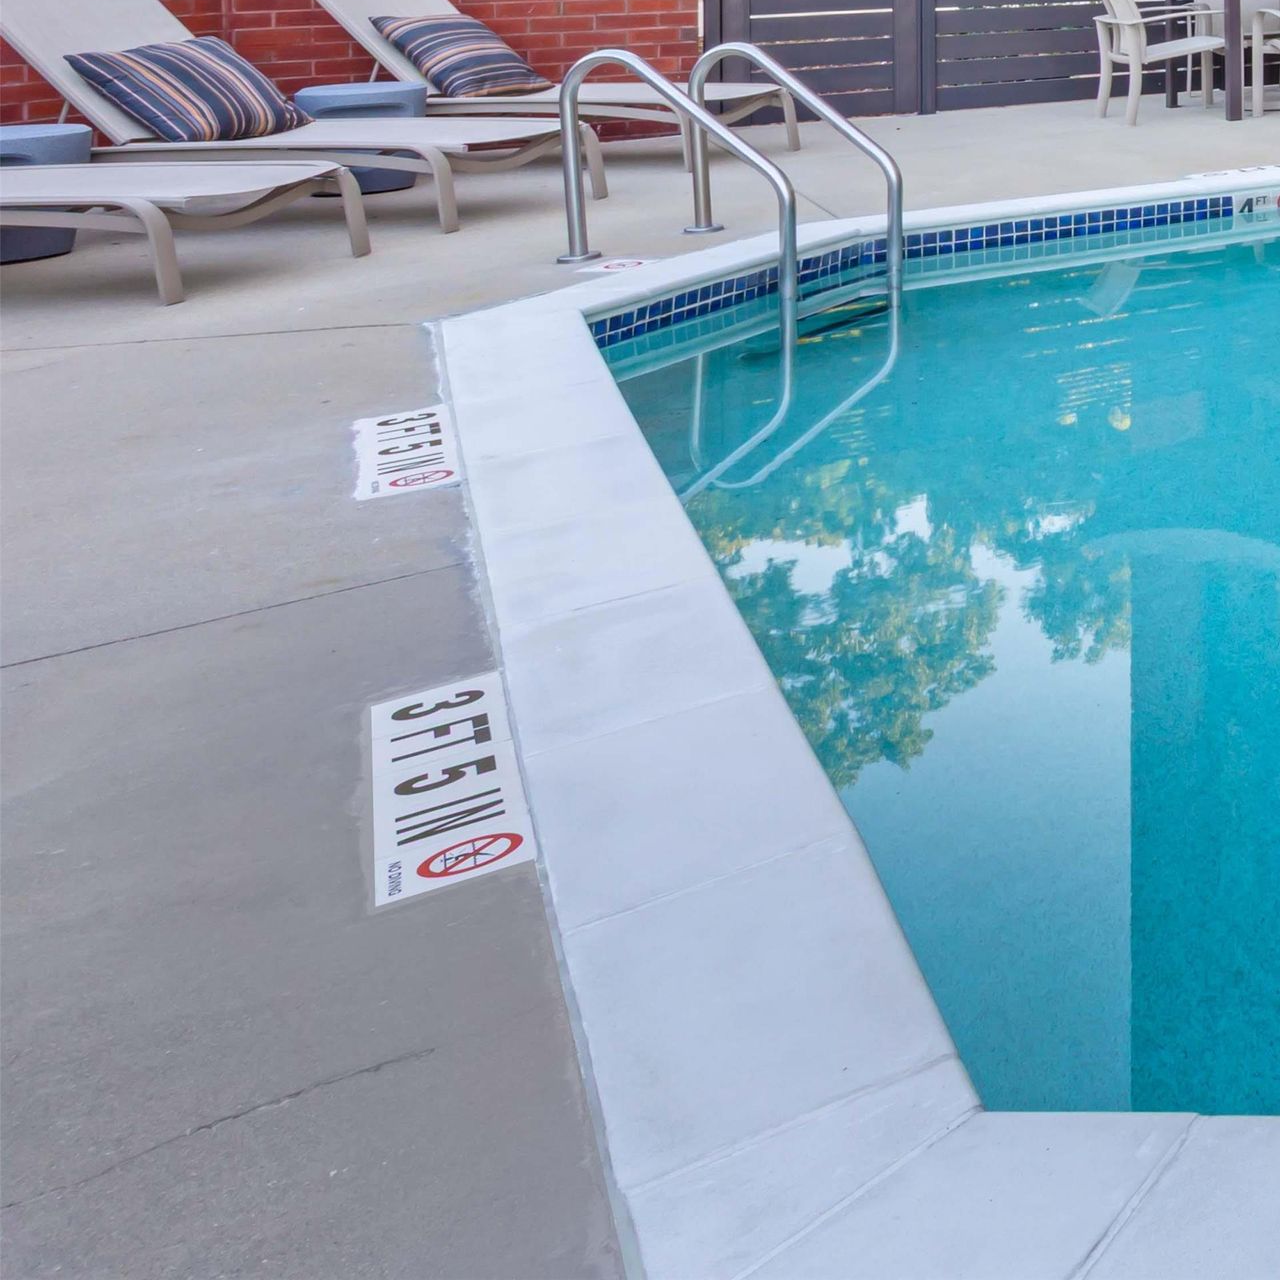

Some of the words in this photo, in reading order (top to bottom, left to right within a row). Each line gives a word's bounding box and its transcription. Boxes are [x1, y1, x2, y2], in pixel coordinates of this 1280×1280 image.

[1256, 195, 1267, 206] FT
[376, 412, 437, 427] 3
[376, 422, 442, 442] FT
[378, 439, 442, 456] 5
[377, 452, 445, 476] IN
[391, 690, 485, 721] 3
[390, 713, 492, 763] FT
[394, 755, 497, 796] 5
[395, 787, 506, 846] IN
